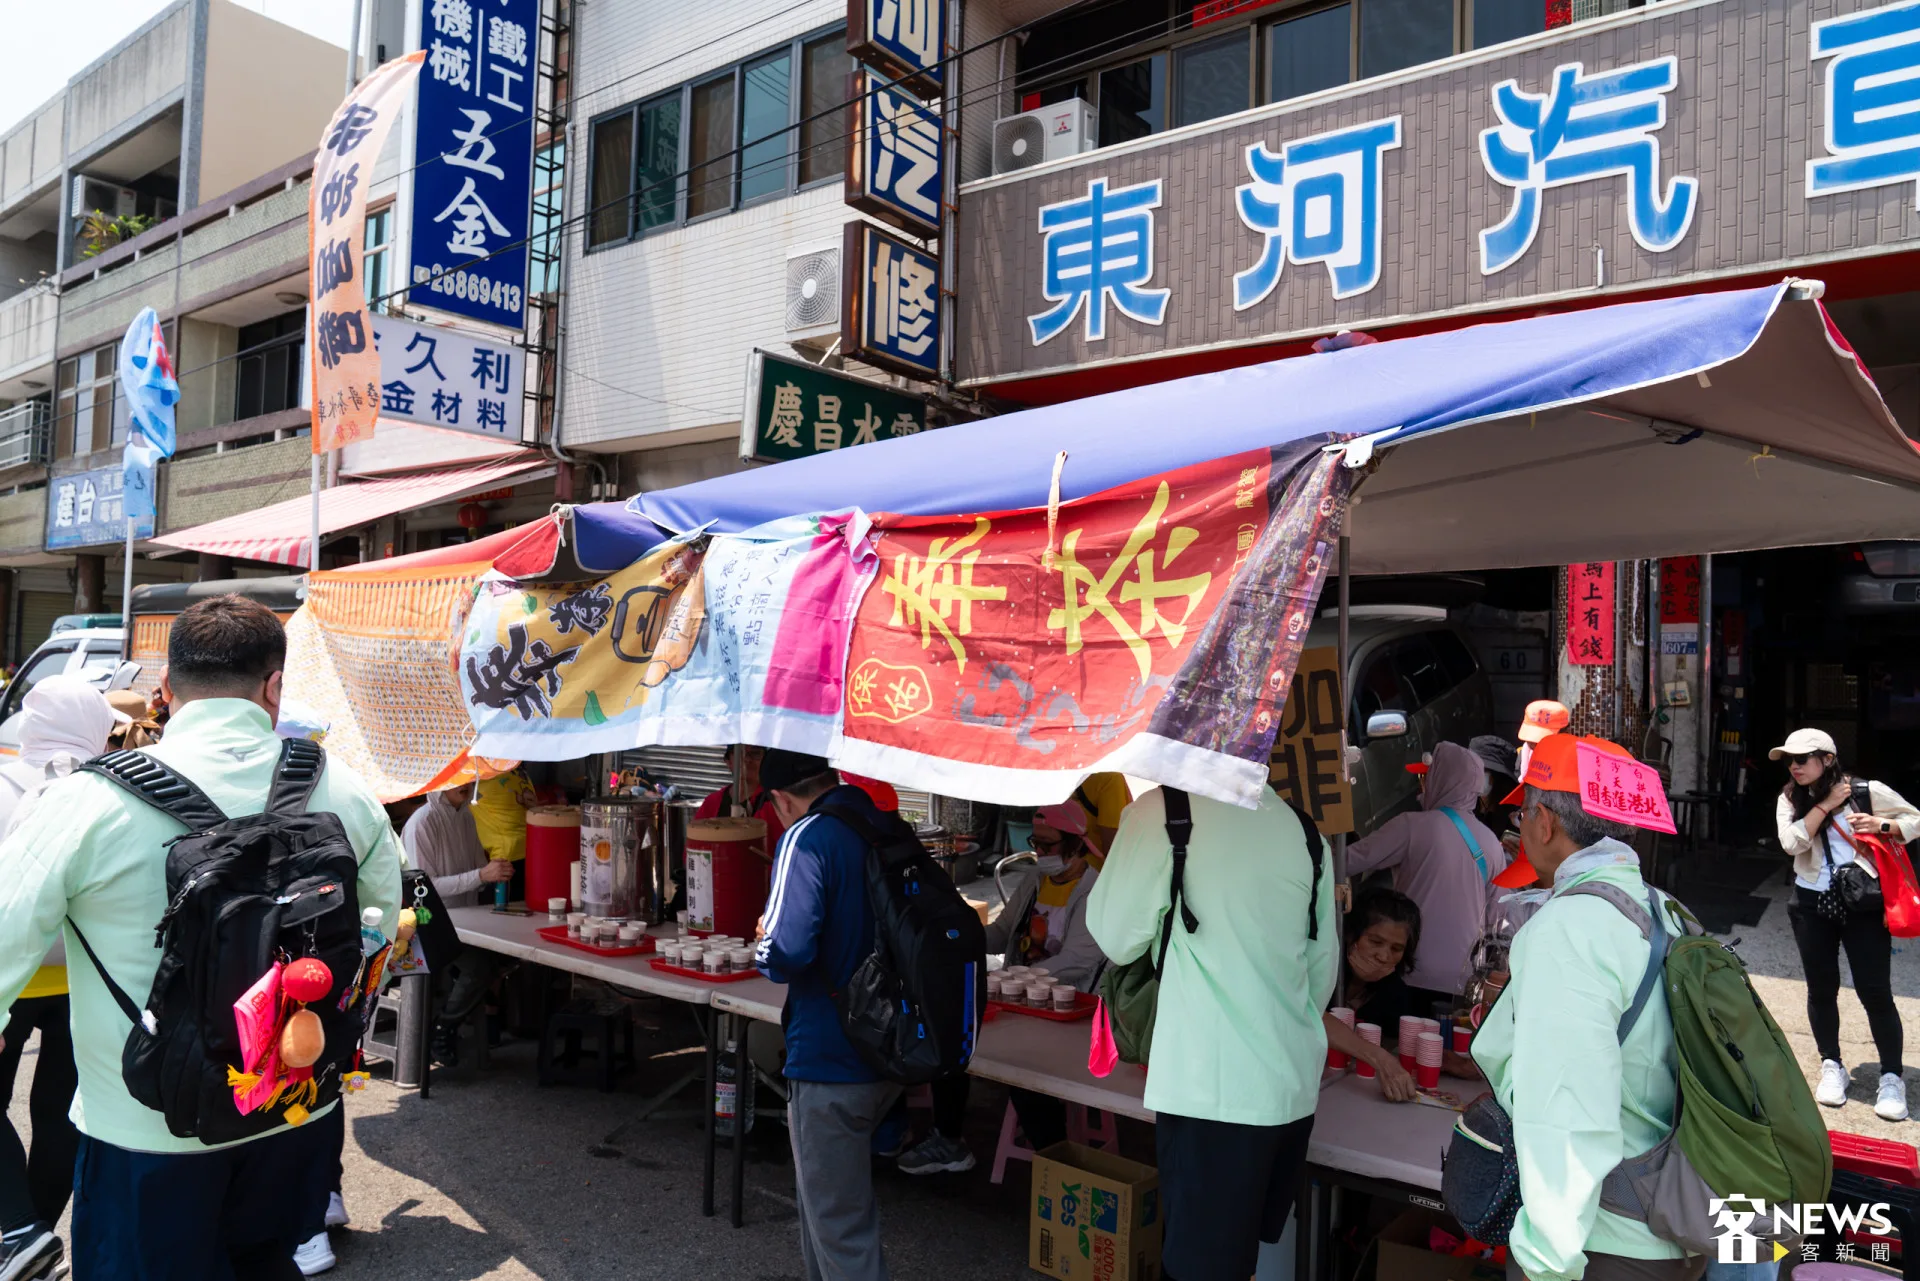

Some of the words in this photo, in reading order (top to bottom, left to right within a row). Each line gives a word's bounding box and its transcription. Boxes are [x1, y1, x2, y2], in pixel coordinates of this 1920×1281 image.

[429, 0, 473, 93] 機械
[486, 0, 528, 113] 鐵工
[433, 107, 512, 261] 五金
[431, 263, 522, 313] 26869413
[872, 241, 936, 357] 修
[372, 331, 511, 395] 久利
[881, 480, 1213, 686] 奉茶
[1578, 562, 1604, 661] 馬上有錢
[850, 665, 923, 719] 保佑
[1587, 781, 1662, 818] 北港進香團
[1412, 1196, 1442, 1210] LIFETIME
